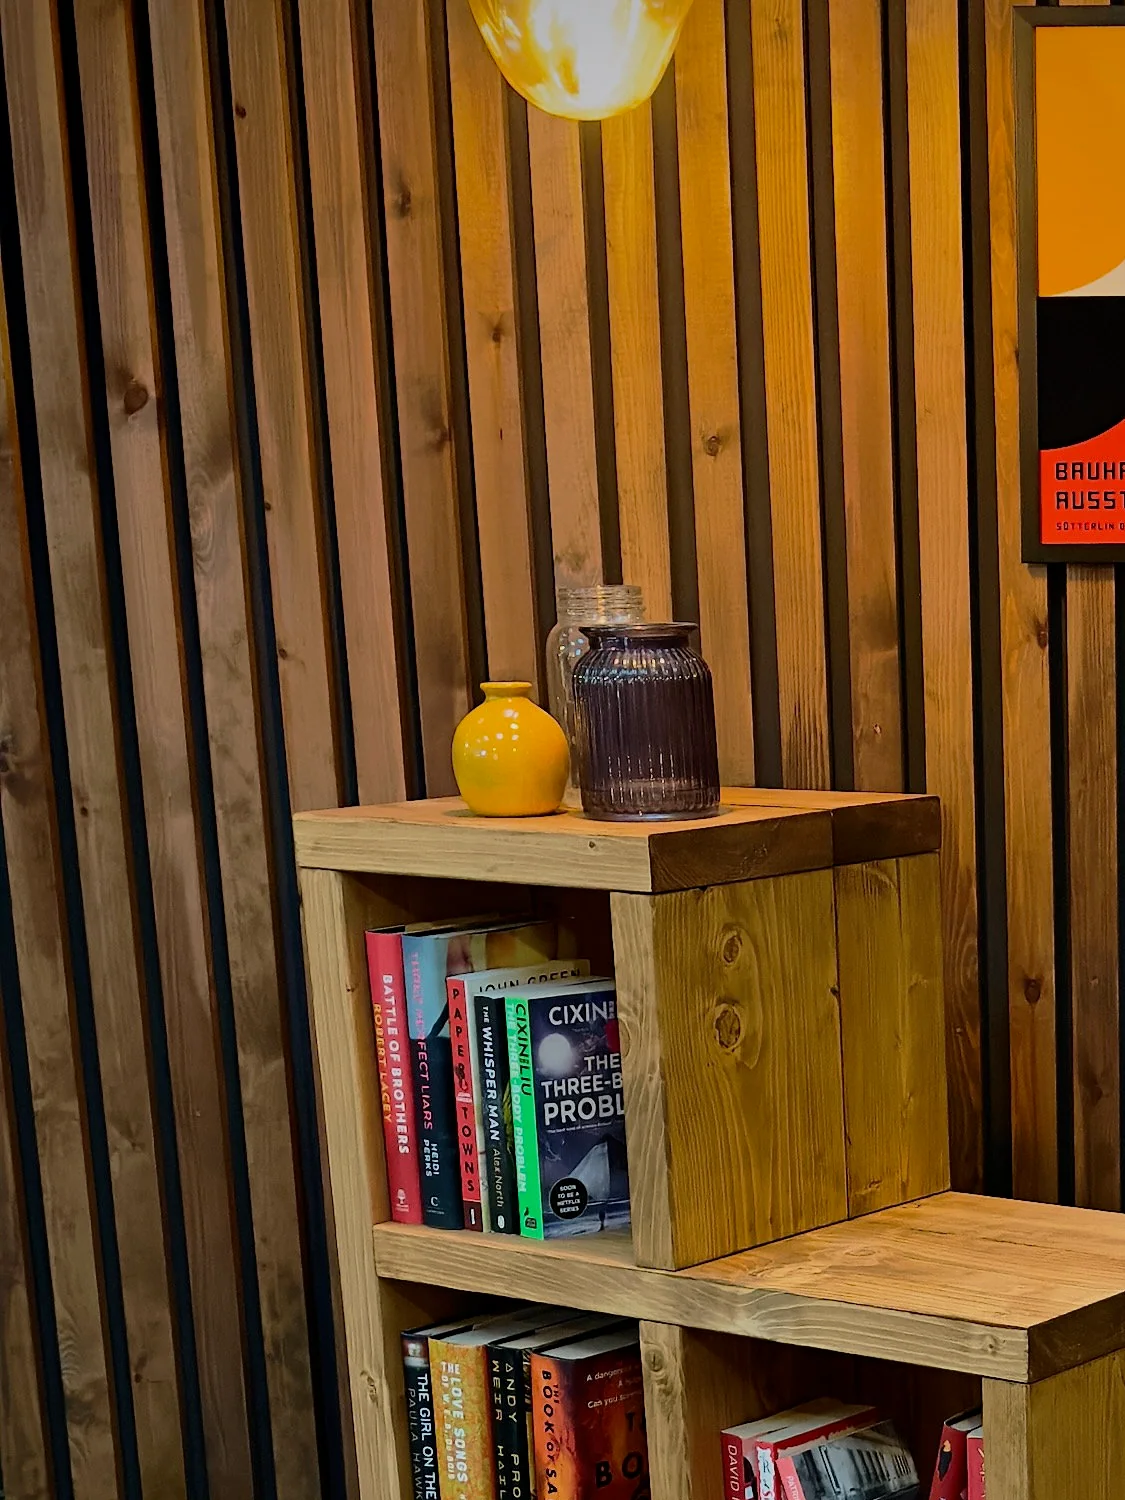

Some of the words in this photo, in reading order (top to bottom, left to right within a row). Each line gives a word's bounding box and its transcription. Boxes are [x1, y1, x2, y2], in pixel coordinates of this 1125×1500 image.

[382, 974, 398, 1035] BATTLE
[482, 1005, 490, 1023] THE
[548, 1000, 608, 1026] CIXIN
[373, 1003, 387, 1068] ROBERT
[388, 1040, 401, 1060] OF
[415, 1009, 430, 1081] PERFECT
[515, 1003, 529, 1060] CIXIN
[482, 1026, 498, 1100] WHISPER
[520, 1065, 531, 1097] LIU
[583, 1053, 620, 1072] THE
[379, 1072, 392, 1122] LACEY
[391, 1067, 410, 1154] BROTHERS
[421, 1085, 433, 1130] LIARS
[452, 988, 466, 1078] PAPER
[462, 1107, 475, 1192] TOWNS
[488, 1104, 500, 1142] MAN
[423, 1139, 433, 1177] PERKS
[430, 1143, 440, 1175] HEIDI
[492, 1148, 502, 1174] Alex
[494, 1176, 505, 1208] North
[417, 1372, 430, 1402] THE
[450, 1377, 464, 1420] LOVE
[492, 1359, 503, 1421] WEIR
[505, 1363, 518, 1423] ANDY
[542, 1370, 554, 1433] BOOK
[407, 1387, 419, 1442] PAULA
[419, 1407, 432, 1441] GIRL
[422, 1446, 435, 1467] ON
[454, 1427, 468, 1483] SONGS
[497, 1445, 507, 1500] HAIL
[727, 1444, 740, 1492] DAVID
[424, 1472, 437, 1500] THE
